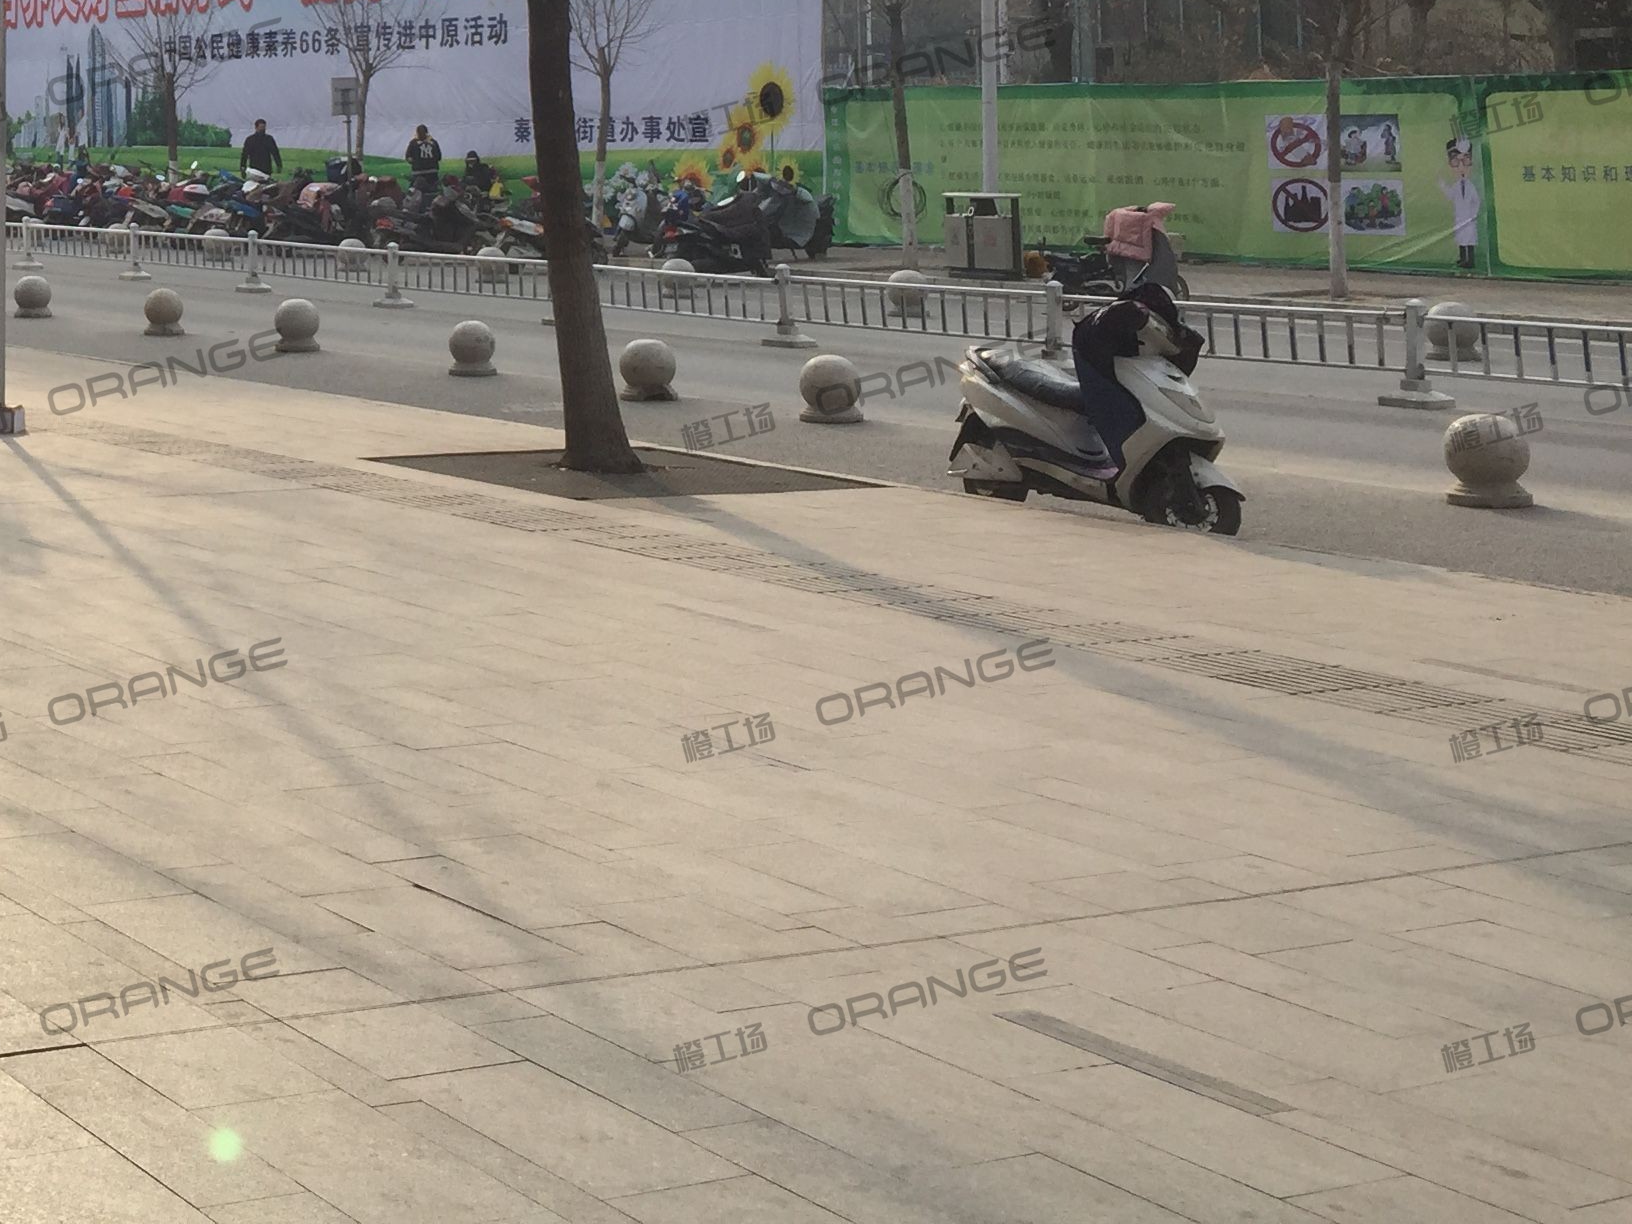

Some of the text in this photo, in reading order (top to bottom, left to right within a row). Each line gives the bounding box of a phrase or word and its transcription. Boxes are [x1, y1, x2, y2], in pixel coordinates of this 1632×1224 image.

[515, 115, 709, 143] 秦街道办事处宣
